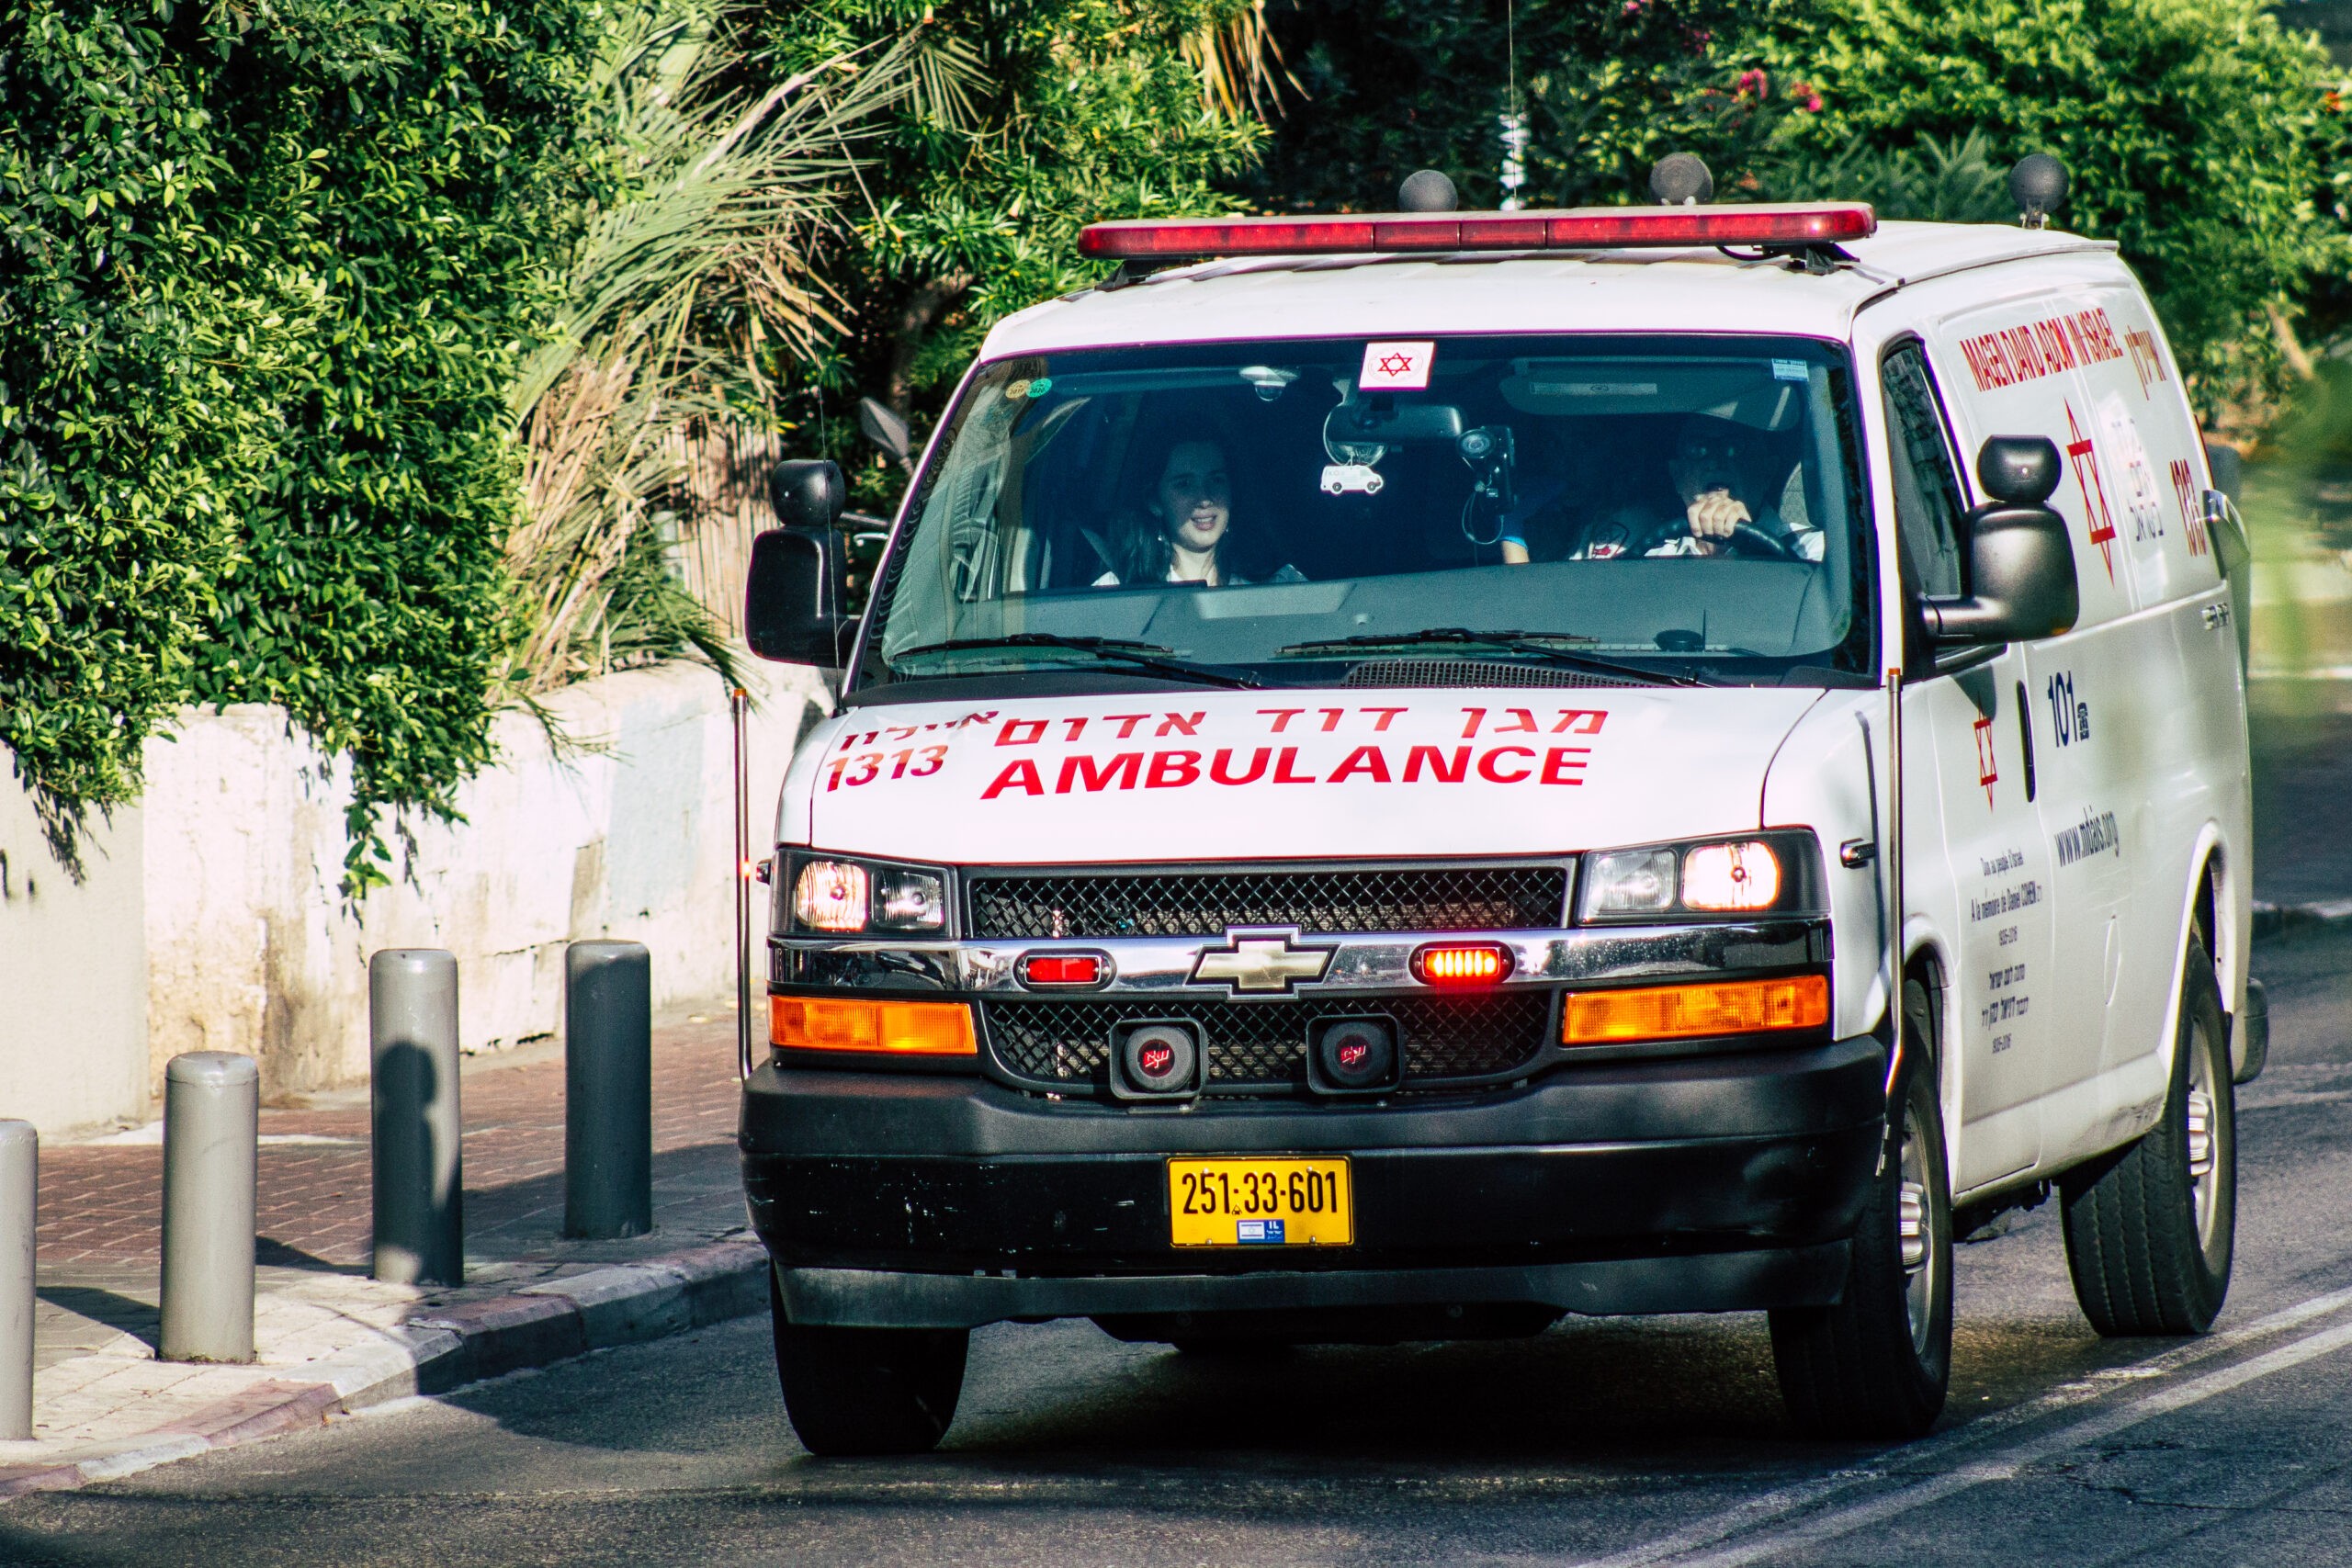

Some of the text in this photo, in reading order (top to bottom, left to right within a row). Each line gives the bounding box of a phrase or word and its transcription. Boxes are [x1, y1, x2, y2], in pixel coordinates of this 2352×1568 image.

[1959, 307, 2124, 392] MAGEN DAVID ADOM IN ISRAEL
[839, 710, 1001, 752] איילון
[993, 706, 1609, 747] מגן דוד אדום
[2048, 671, 2078, 749] 101
[826, 745, 948, 793] 1313
[979, 746, 1592, 800] AMBULANCE
[2054, 804, 2120, 868] www.mdais.org
[1269, 1220, 1280, 1230] IL
